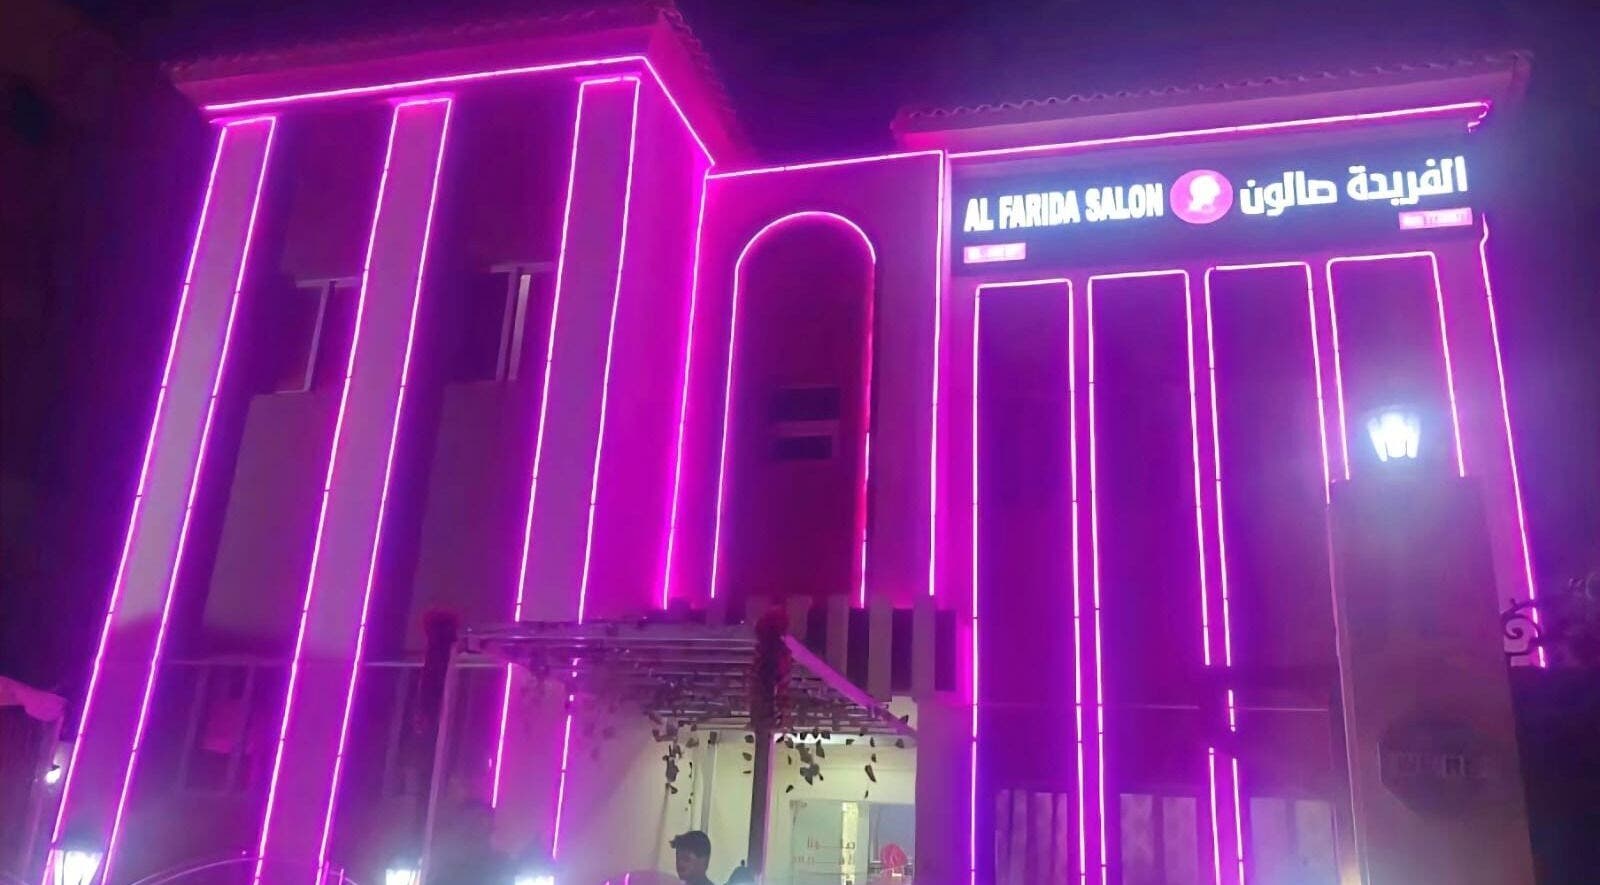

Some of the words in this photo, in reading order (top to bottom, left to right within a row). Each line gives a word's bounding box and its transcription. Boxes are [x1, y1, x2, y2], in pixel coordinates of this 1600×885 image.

[1239, 170, 1338, 217] صالون
[1347, 156, 1468, 206] الفريدة
[963, 198, 995, 232] AL
[998, 190, 1082, 229] FARIDA
[1084, 183, 1164, 222] SALON
